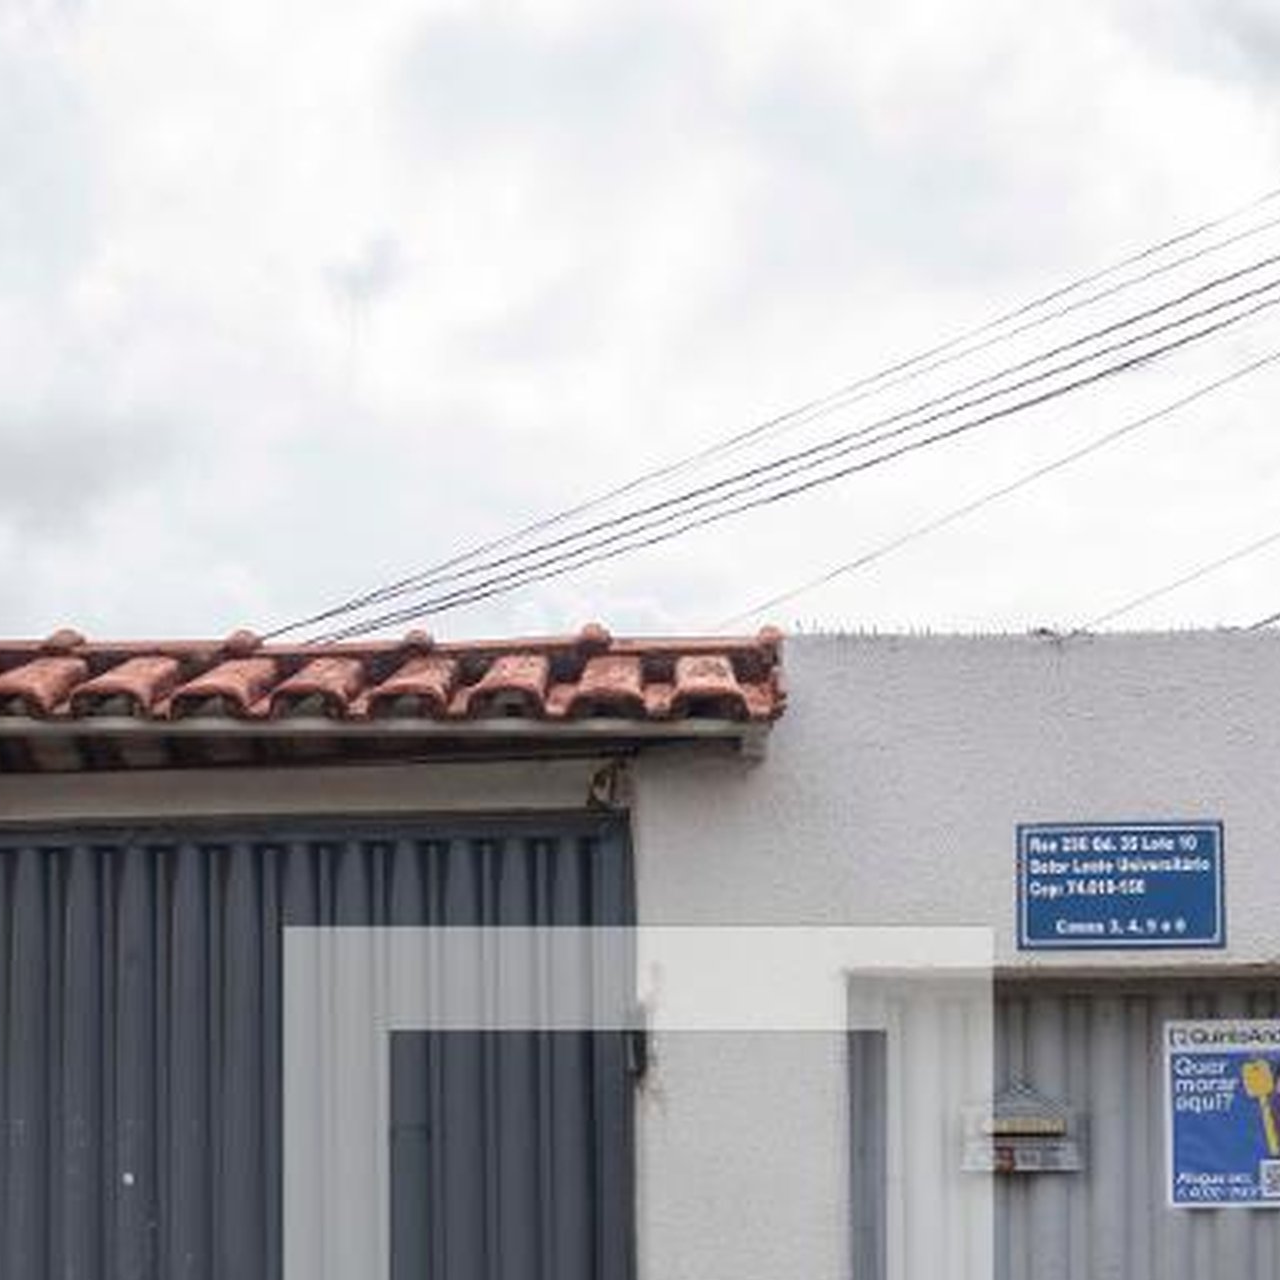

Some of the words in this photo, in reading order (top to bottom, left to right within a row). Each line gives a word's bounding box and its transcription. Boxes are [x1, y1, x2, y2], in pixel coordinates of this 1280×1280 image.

[1029, 836, 1058, 853] Rua
[1141, 835, 1175, 851] Lote
[1029, 860, 1068, 875] Setor
[1072, 860, 1114, 874] Leste
[1056, 918, 1105, 935] Casas
[1174, 1057, 1226, 1077] Quer
[1175, 1079, 1237, 1093] morar
[1175, 1093, 1235, 1114] aqui?
